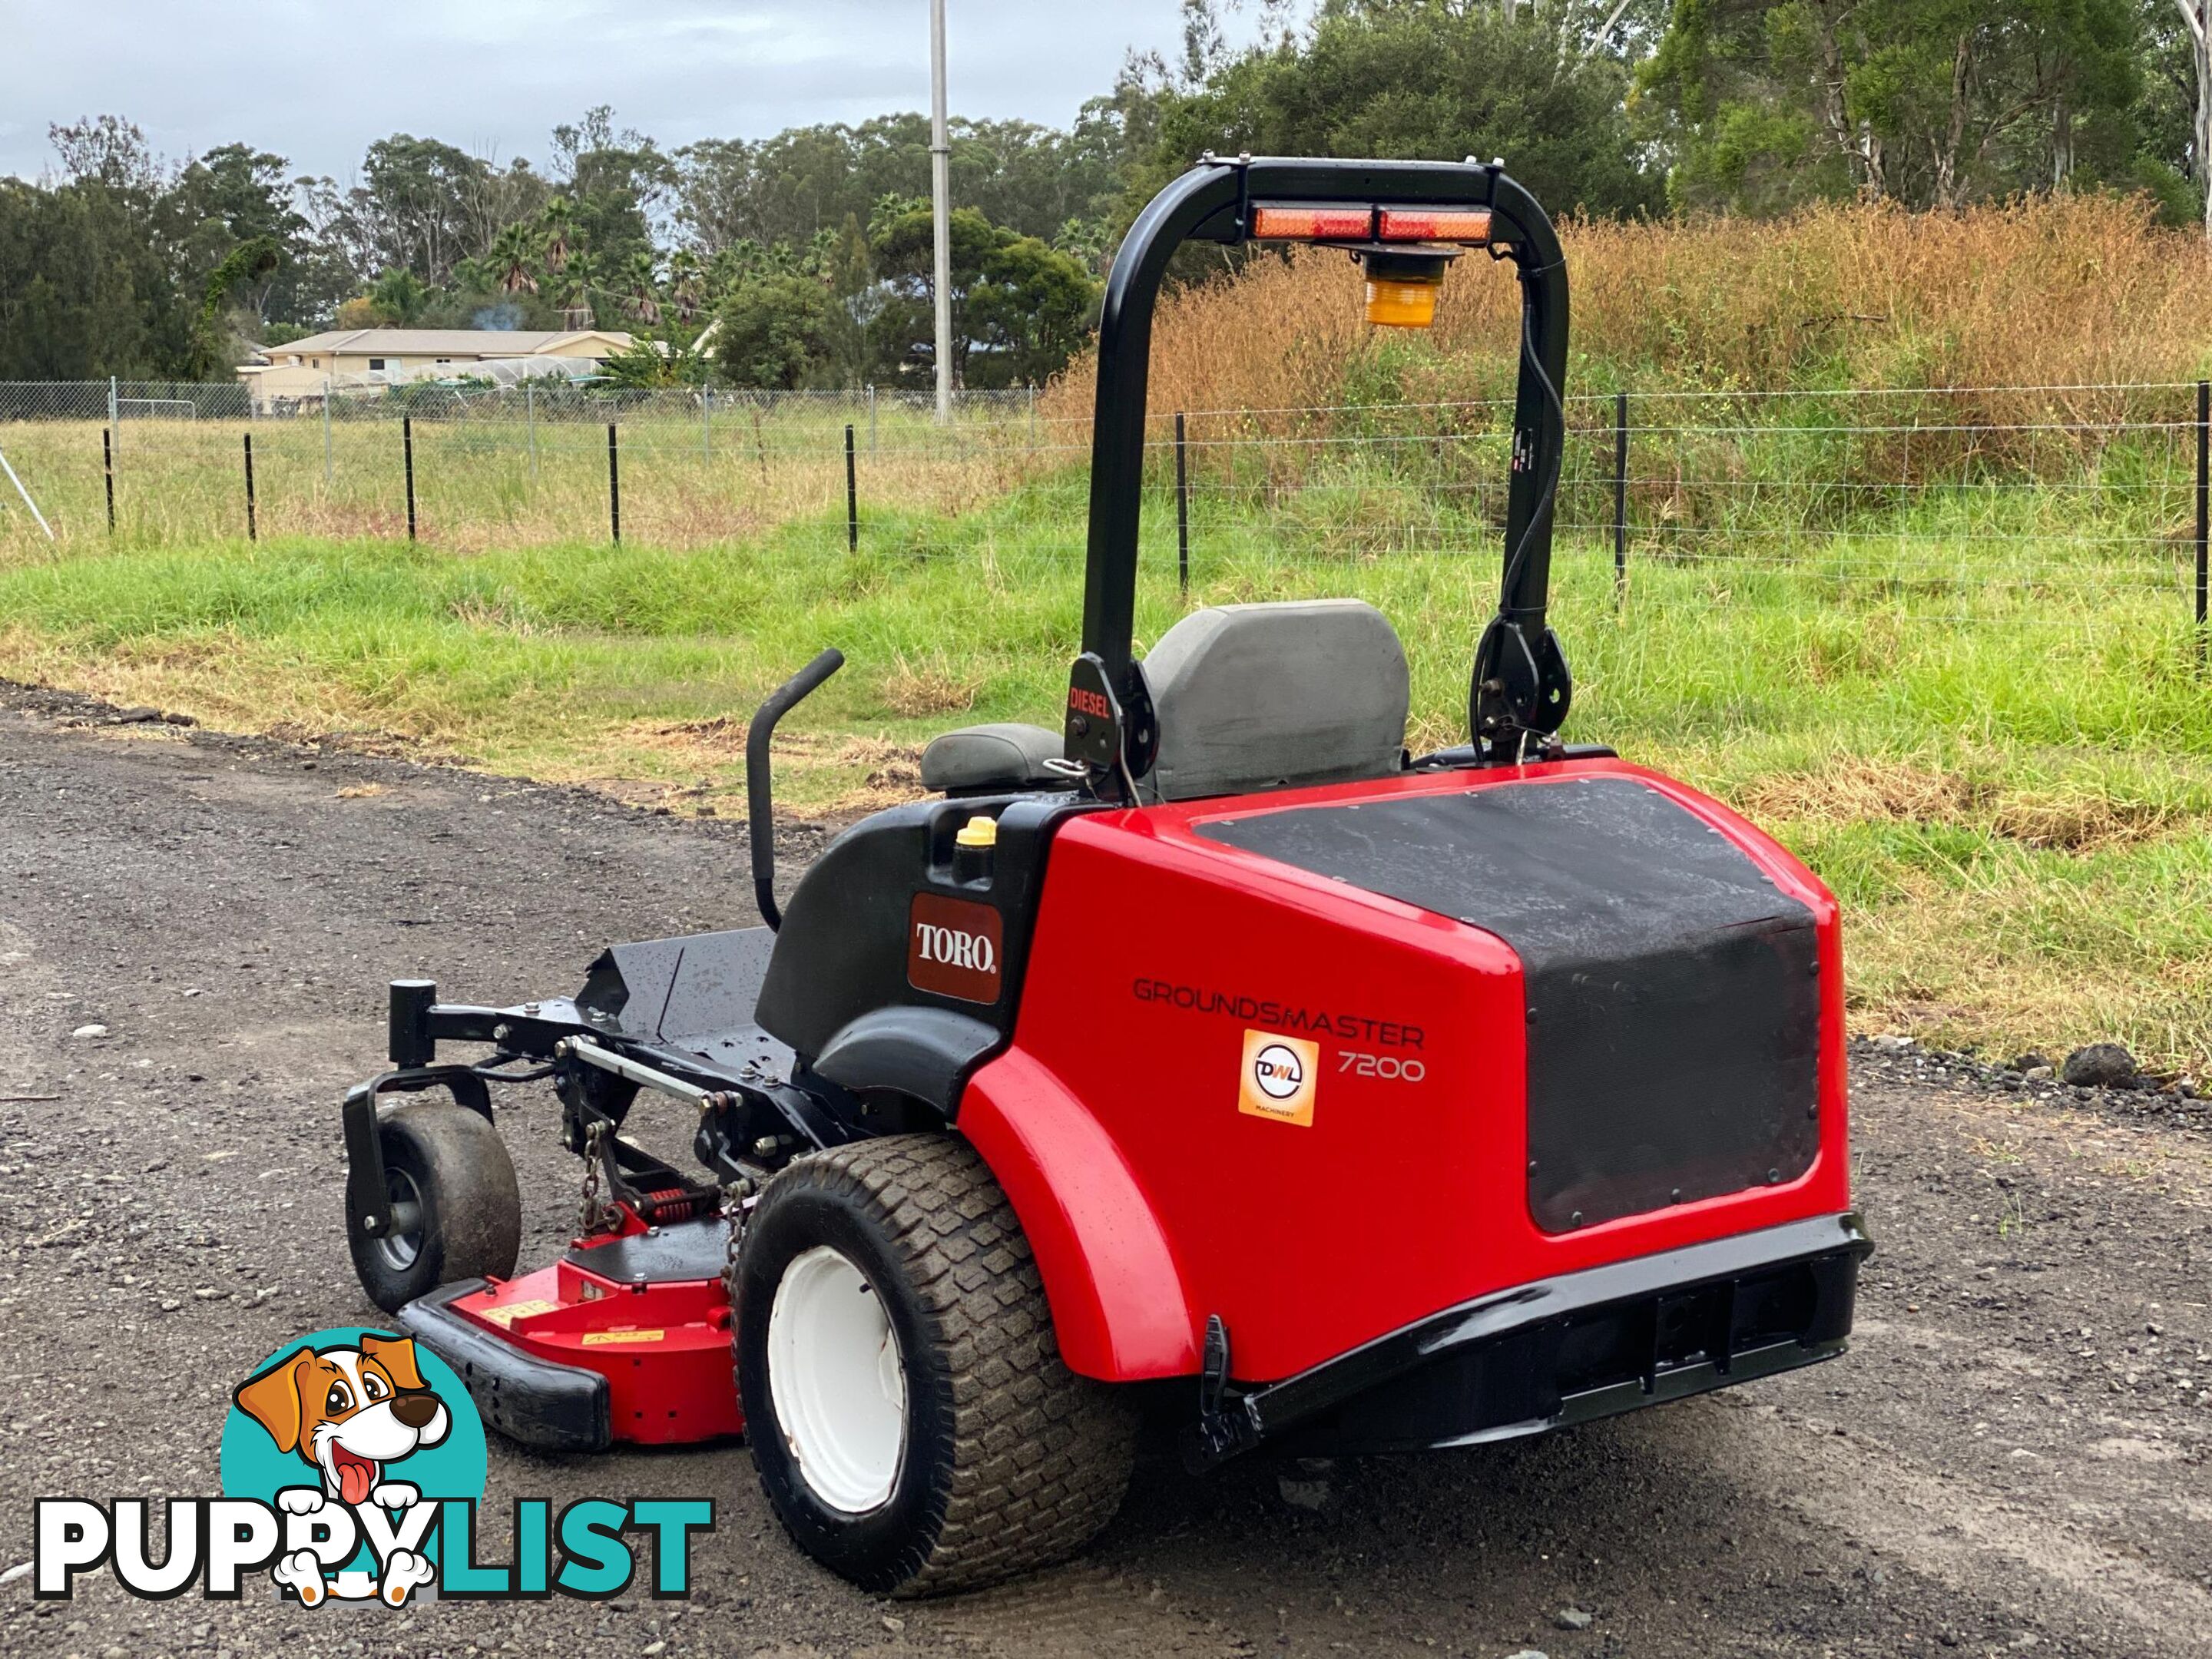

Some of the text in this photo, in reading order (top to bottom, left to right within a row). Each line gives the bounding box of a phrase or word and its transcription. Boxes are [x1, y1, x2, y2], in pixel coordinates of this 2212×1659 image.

[1070, 687, 1109, 719] DIESEL
[1134, 978, 1426, 1049] GROUNDSMASTER
[1256, 1060, 1302, 1082] DWL
[1336, 1051, 1426, 1082] 7200
[1256, 1104, 1295, 1118] MACHINERY
